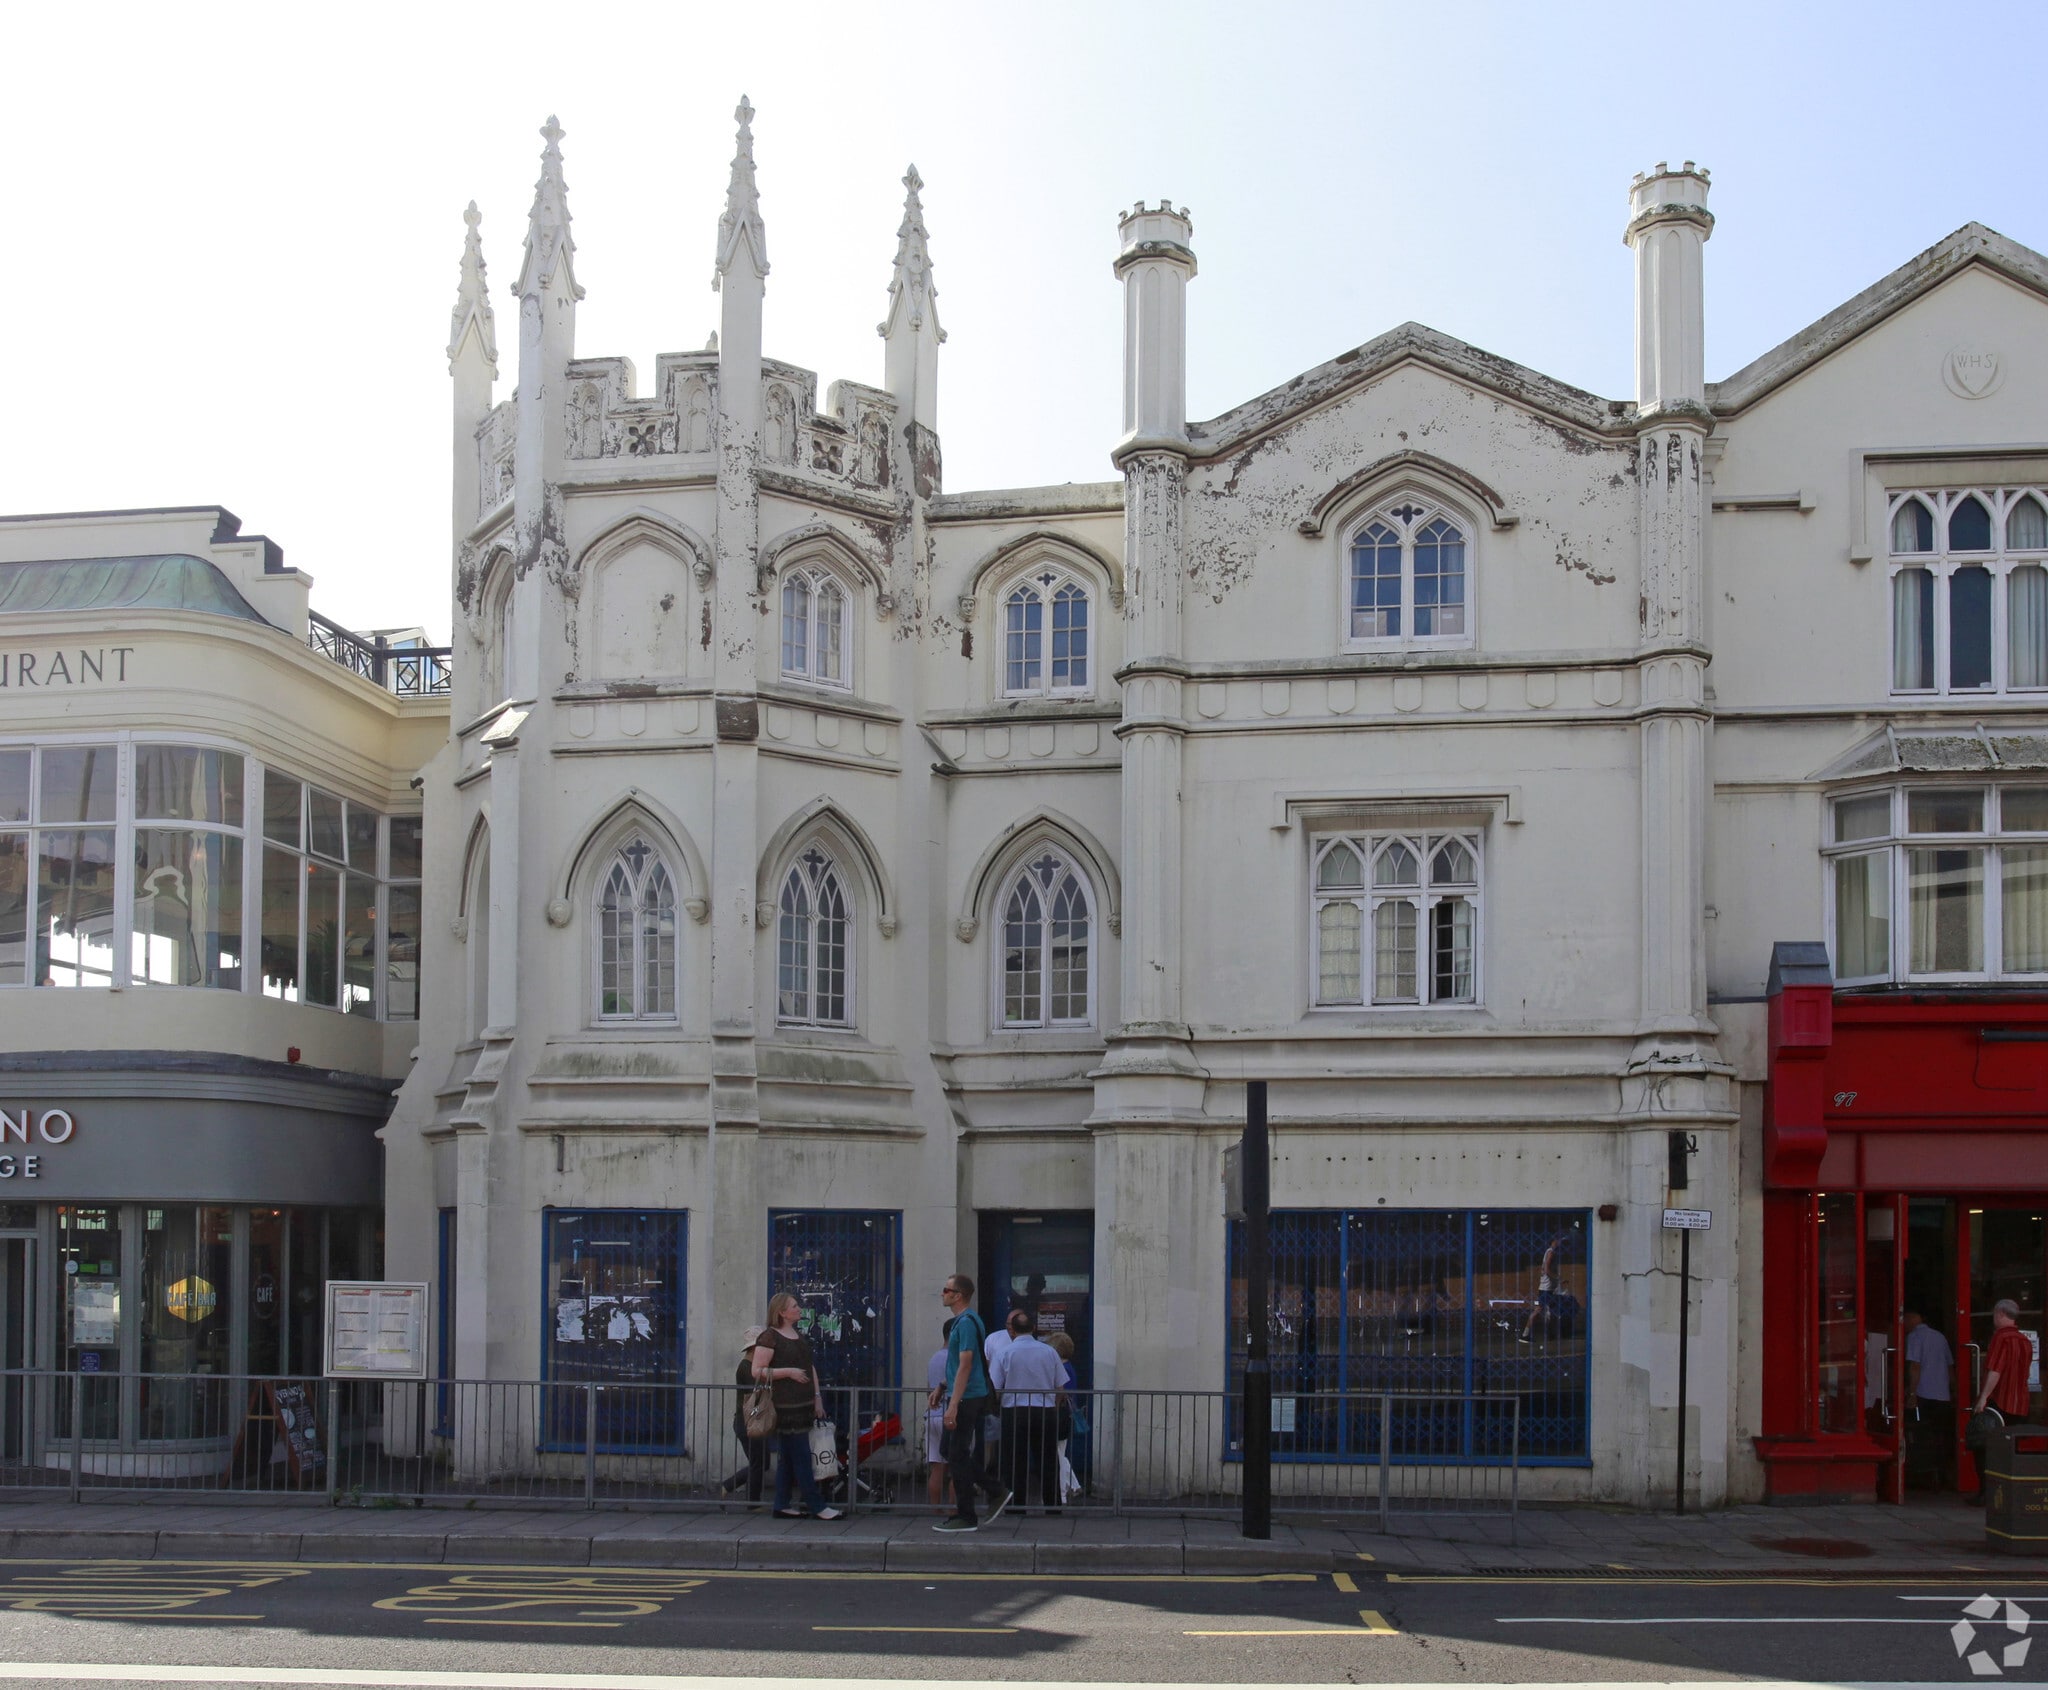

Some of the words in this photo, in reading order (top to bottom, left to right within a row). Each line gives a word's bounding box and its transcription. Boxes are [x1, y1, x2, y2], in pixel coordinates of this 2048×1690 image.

[1956, 353, 1993, 369] WHS
[1833, 1091, 1858, 1108] 97
[197, 1292, 217, 1306] BAR
[256, 1284, 273, 1303] CAFÉ
[372, 1575, 711, 1617] BUS
